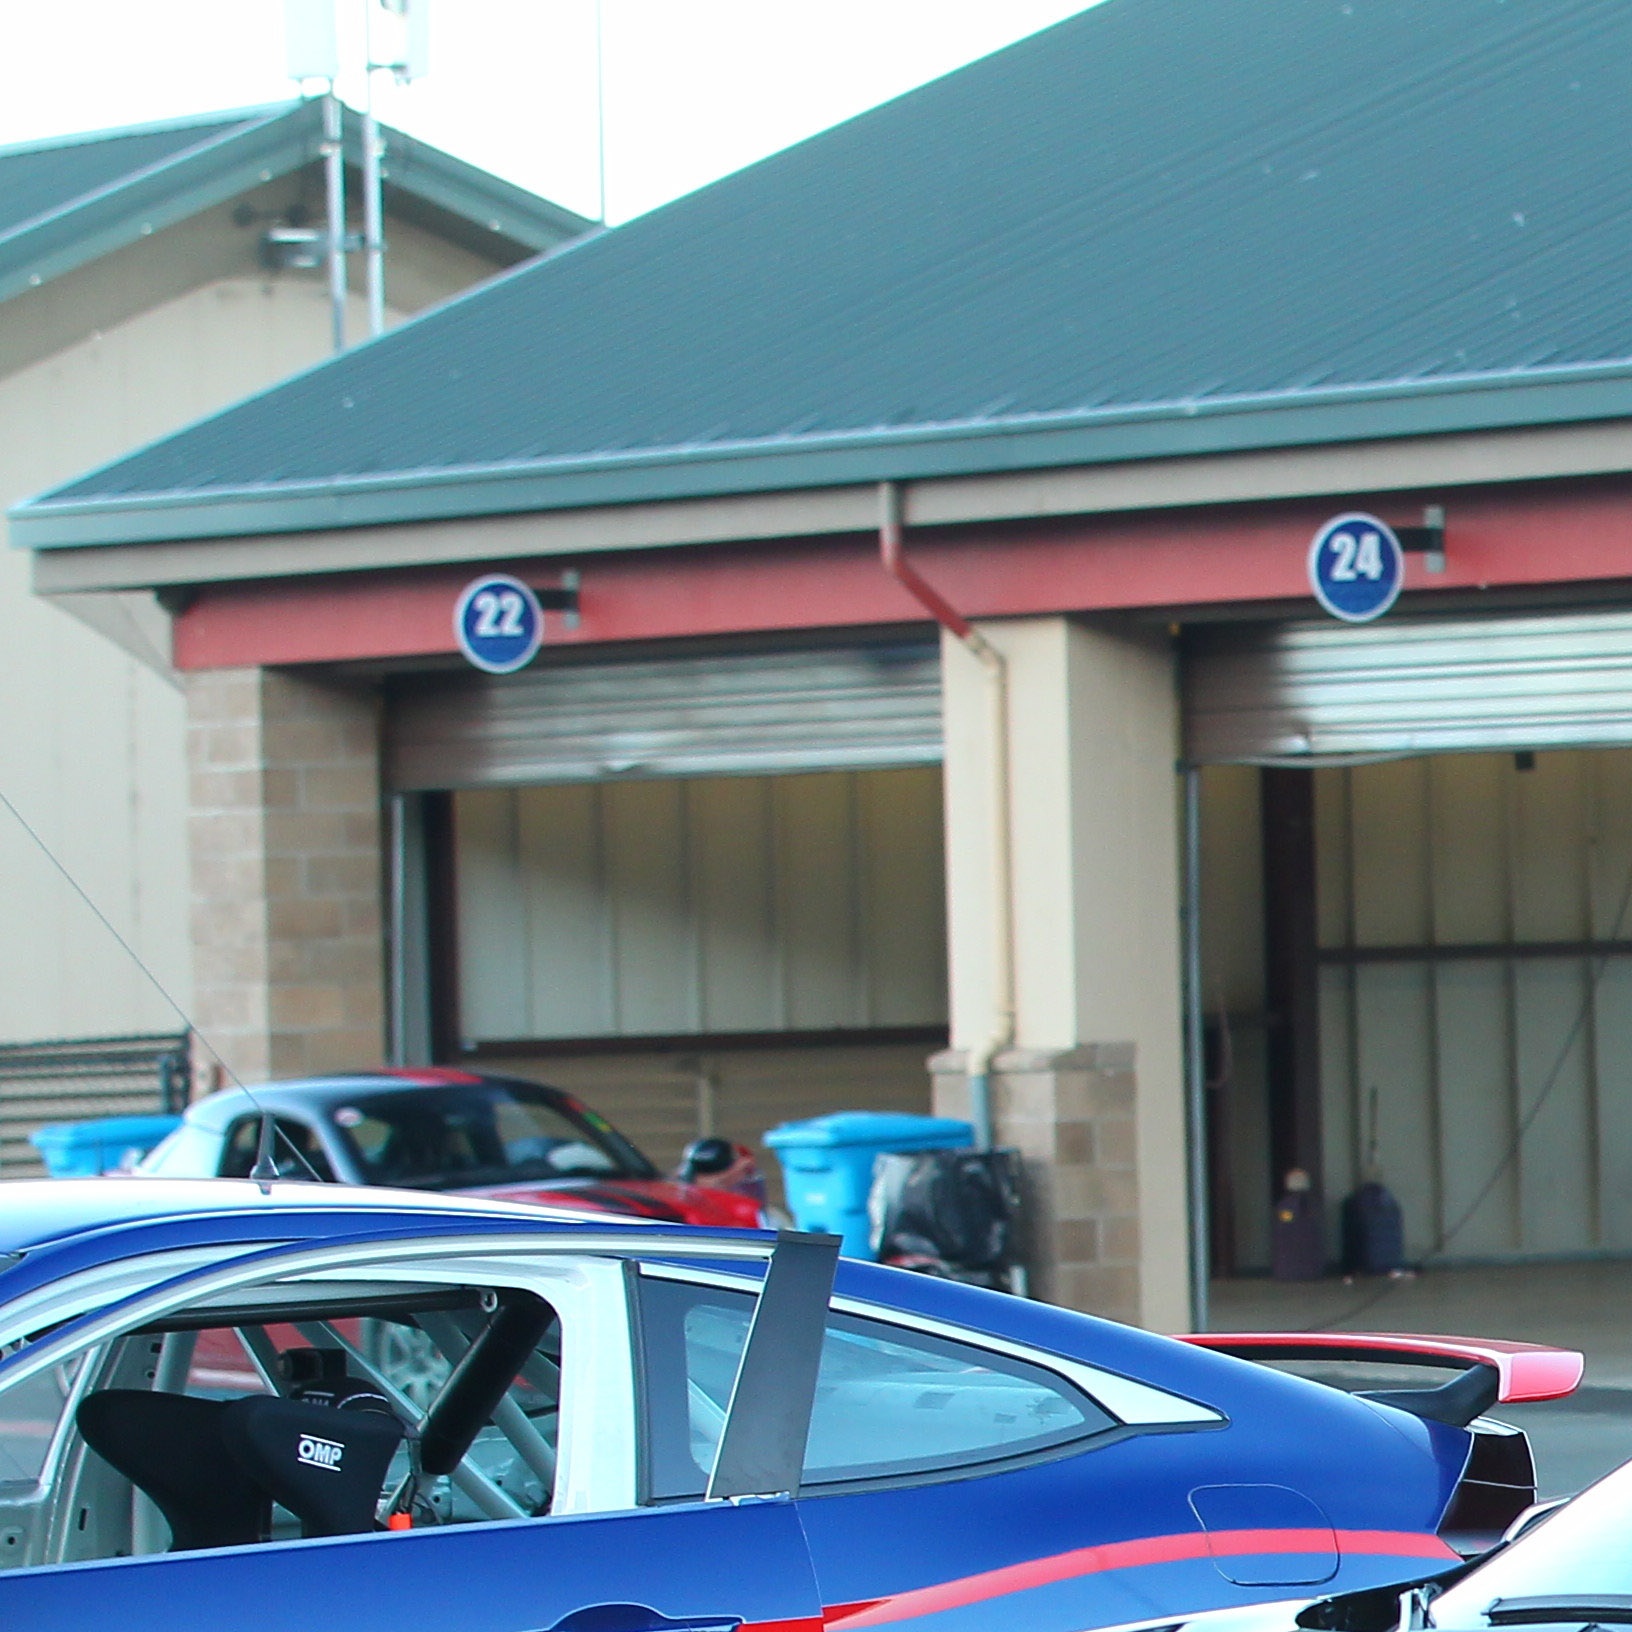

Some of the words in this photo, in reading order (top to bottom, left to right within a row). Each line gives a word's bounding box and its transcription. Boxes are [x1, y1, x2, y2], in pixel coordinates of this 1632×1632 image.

[1328, 532, 1383, 581] 24
[474, 591, 525, 637] 22
[298, 1438, 343, 1466] OMP
